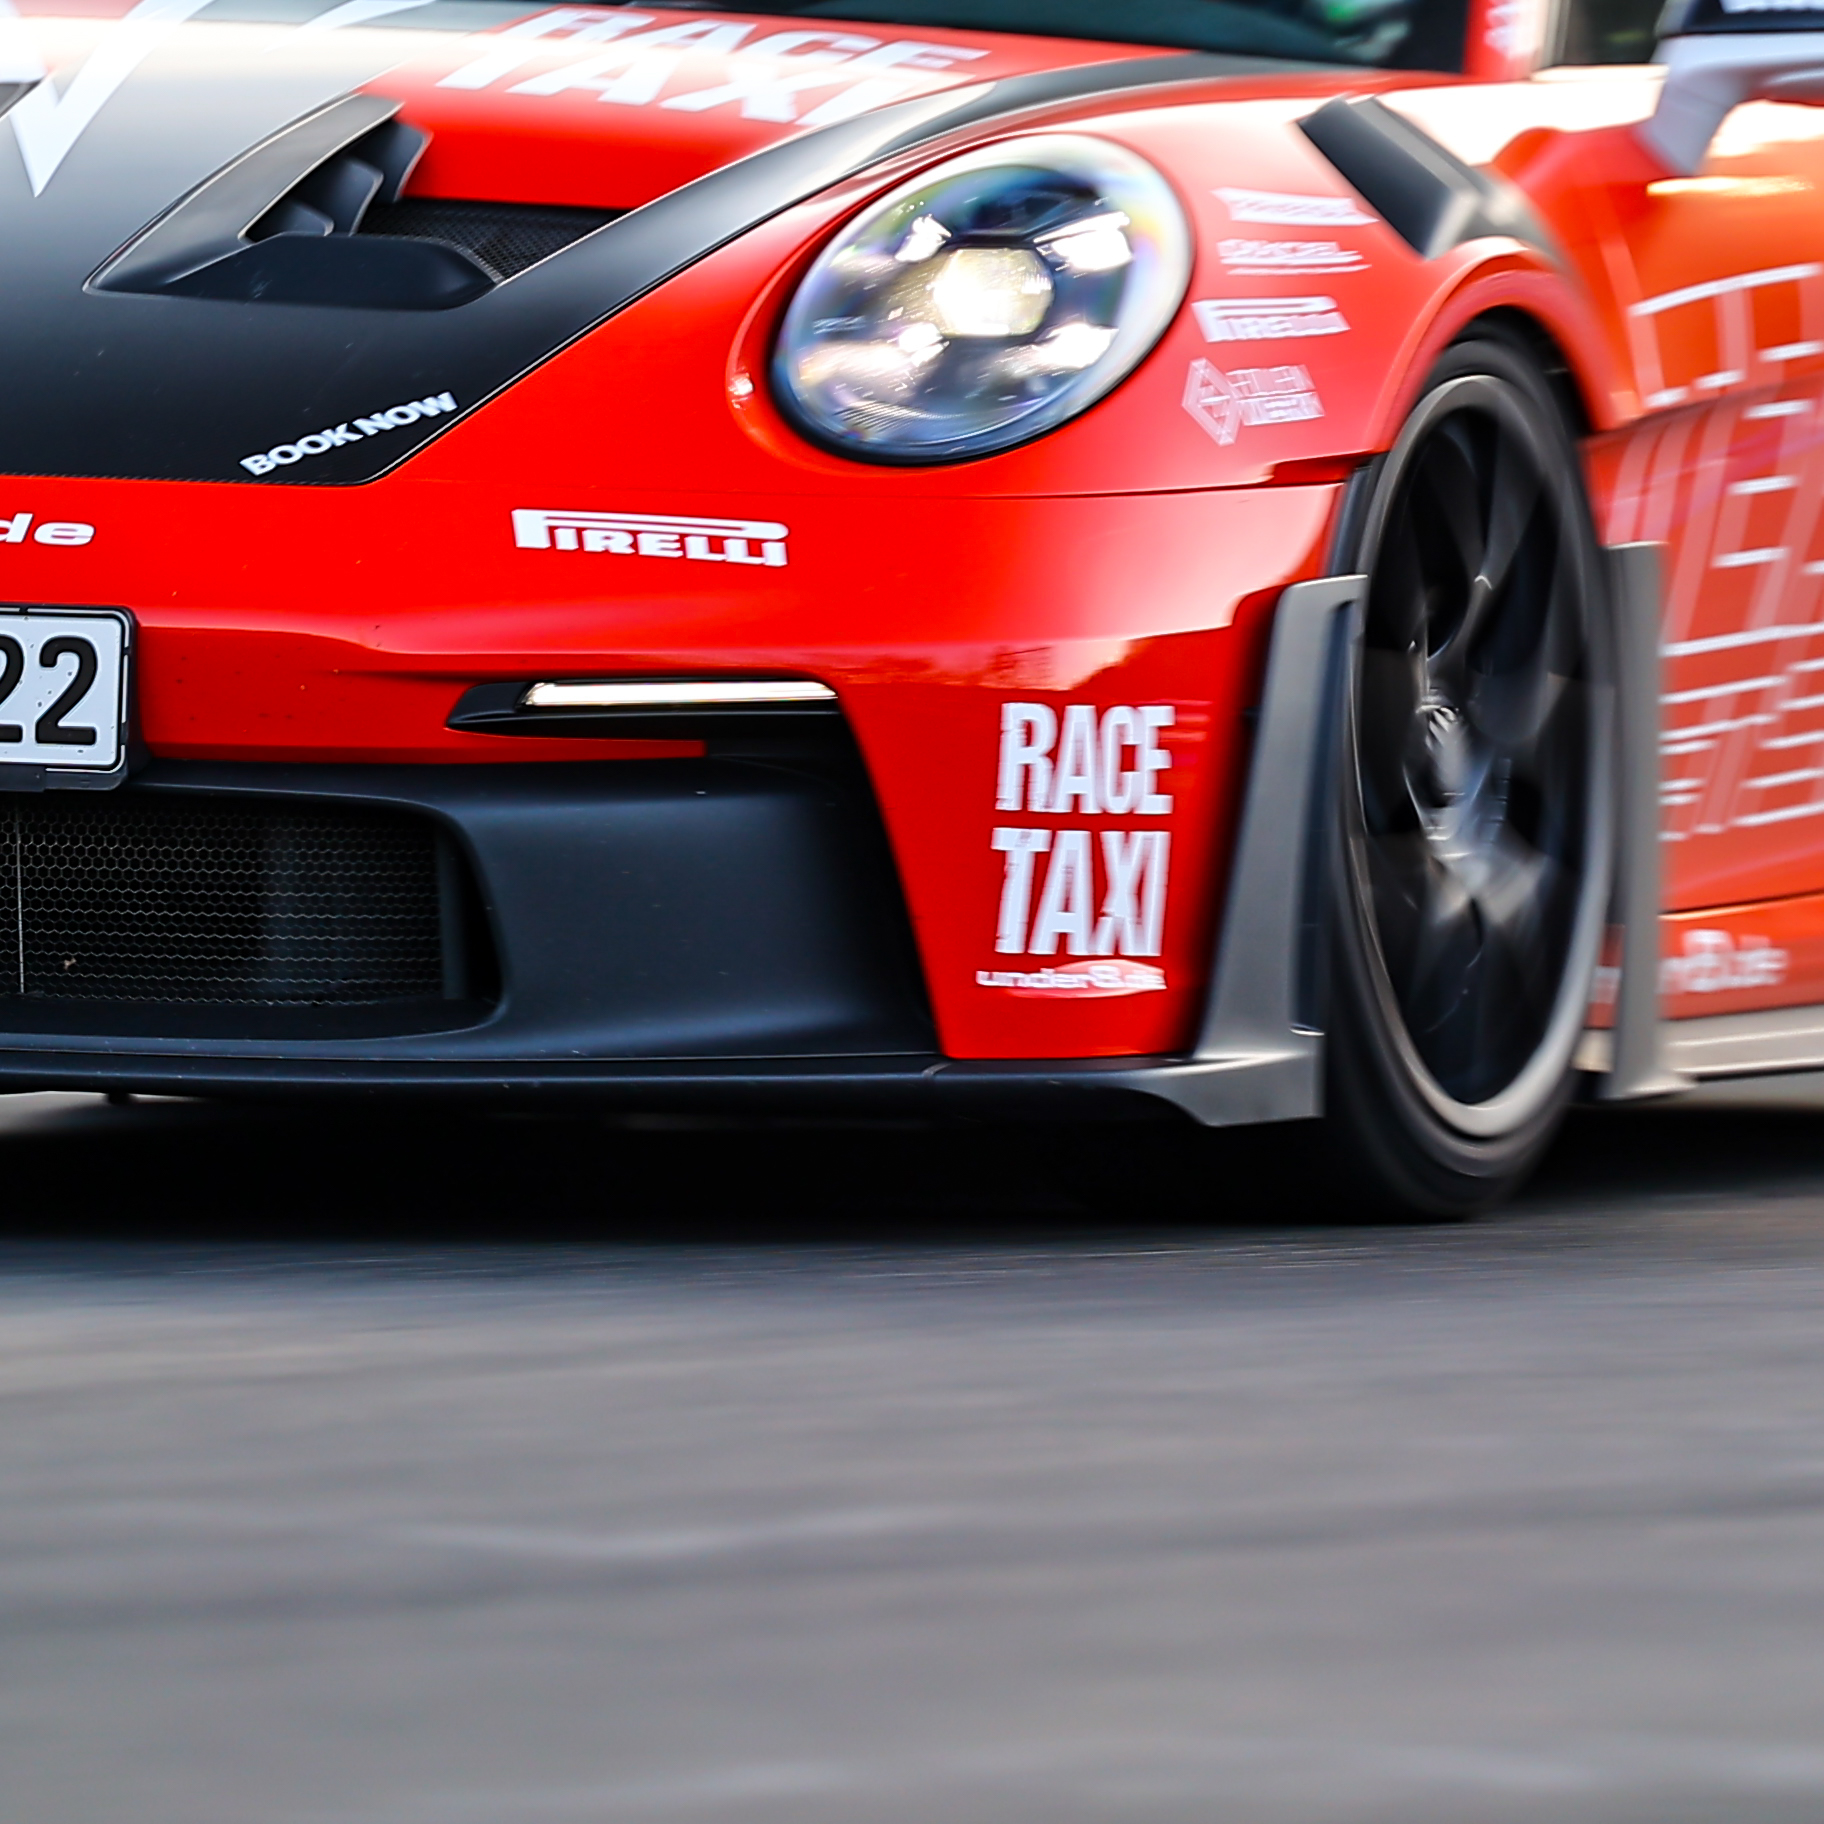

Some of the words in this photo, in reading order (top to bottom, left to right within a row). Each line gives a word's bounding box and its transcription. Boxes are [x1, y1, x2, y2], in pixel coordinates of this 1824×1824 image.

[434, 38, 971, 126] TAXI
[498, 5, 992, 74] RACE
[1190, 295, 1351, 343] PIRE
[238, 422, 364, 476] BOOK
[352, 390, 458, 436] NOW
[511, 508, 789, 567] PIRELLI
[995, 702, 1176, 814] RACE
[990, 827, 1172, 956] TAXI
